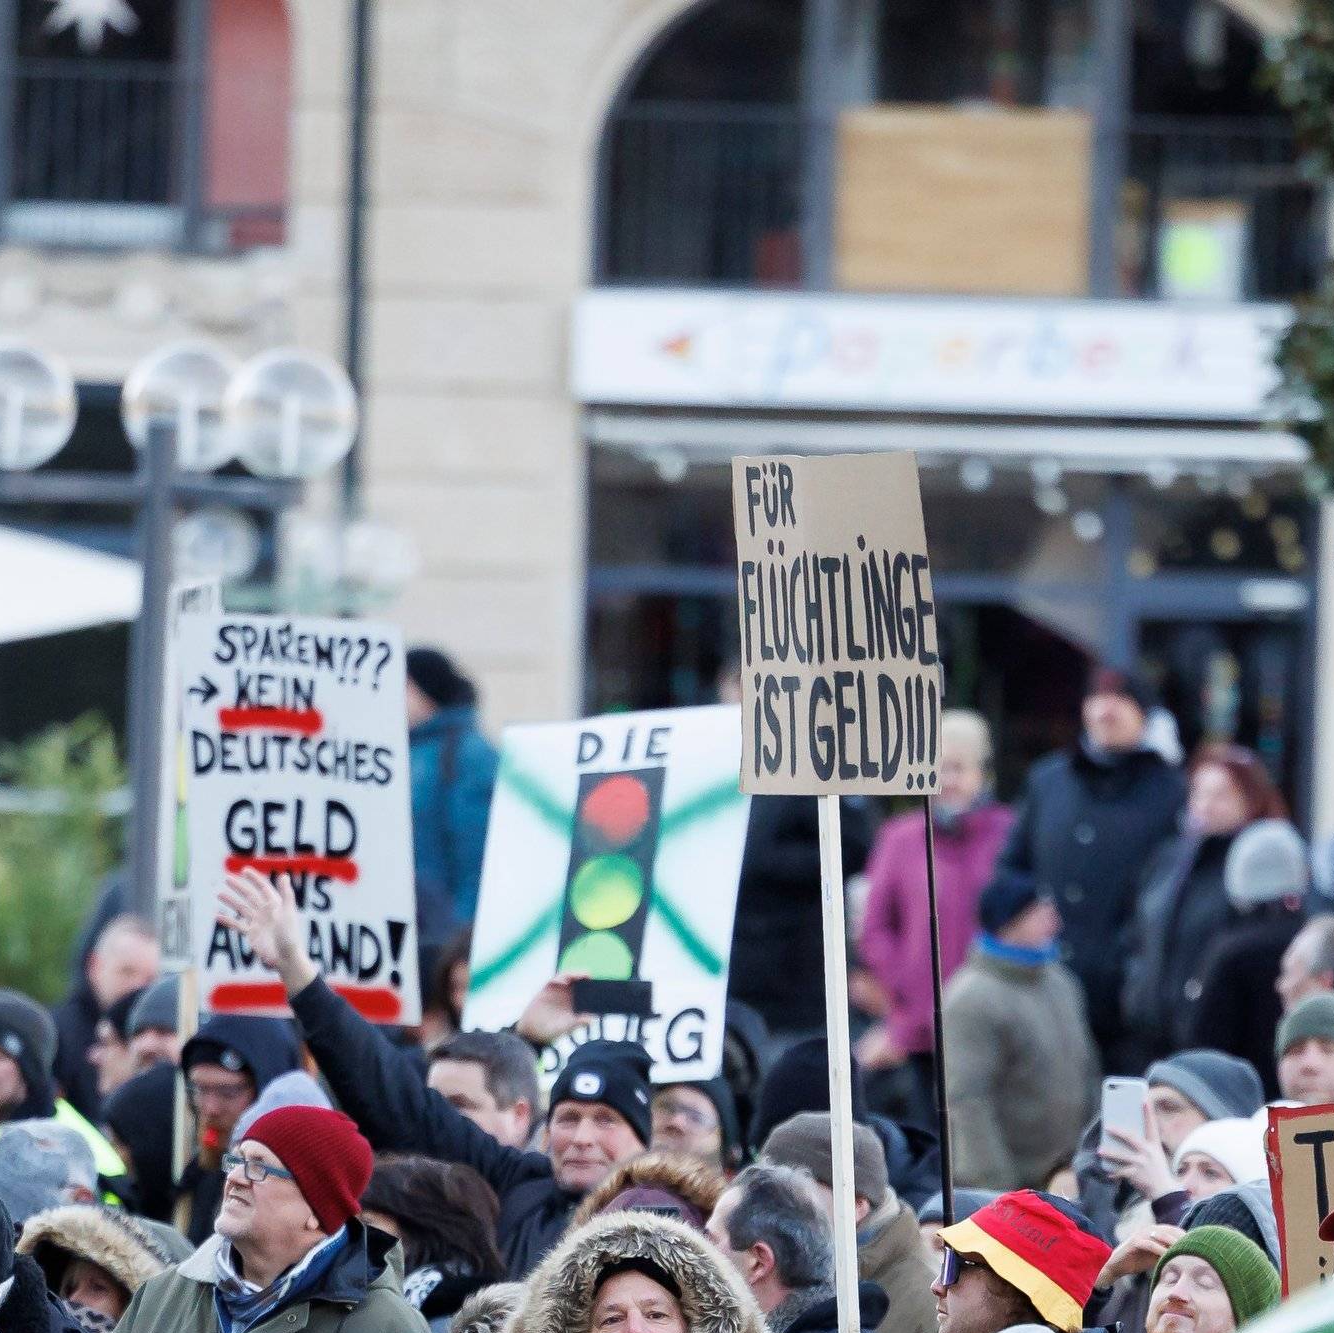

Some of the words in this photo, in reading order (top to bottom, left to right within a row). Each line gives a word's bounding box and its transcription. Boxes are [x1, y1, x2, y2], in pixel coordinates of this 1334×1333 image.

[746, 462, 796, 537] FÜR
[215, 621, 392, 691] SPAREN???
[234, 670, 315, 711] KEIN
[192, 729, 395, 788] DEUTSCHES
[576, 726, 672, 765] DIE
[809, 669, 937, 791] GELD!!!
[223, 798, 359, 860] GELD
